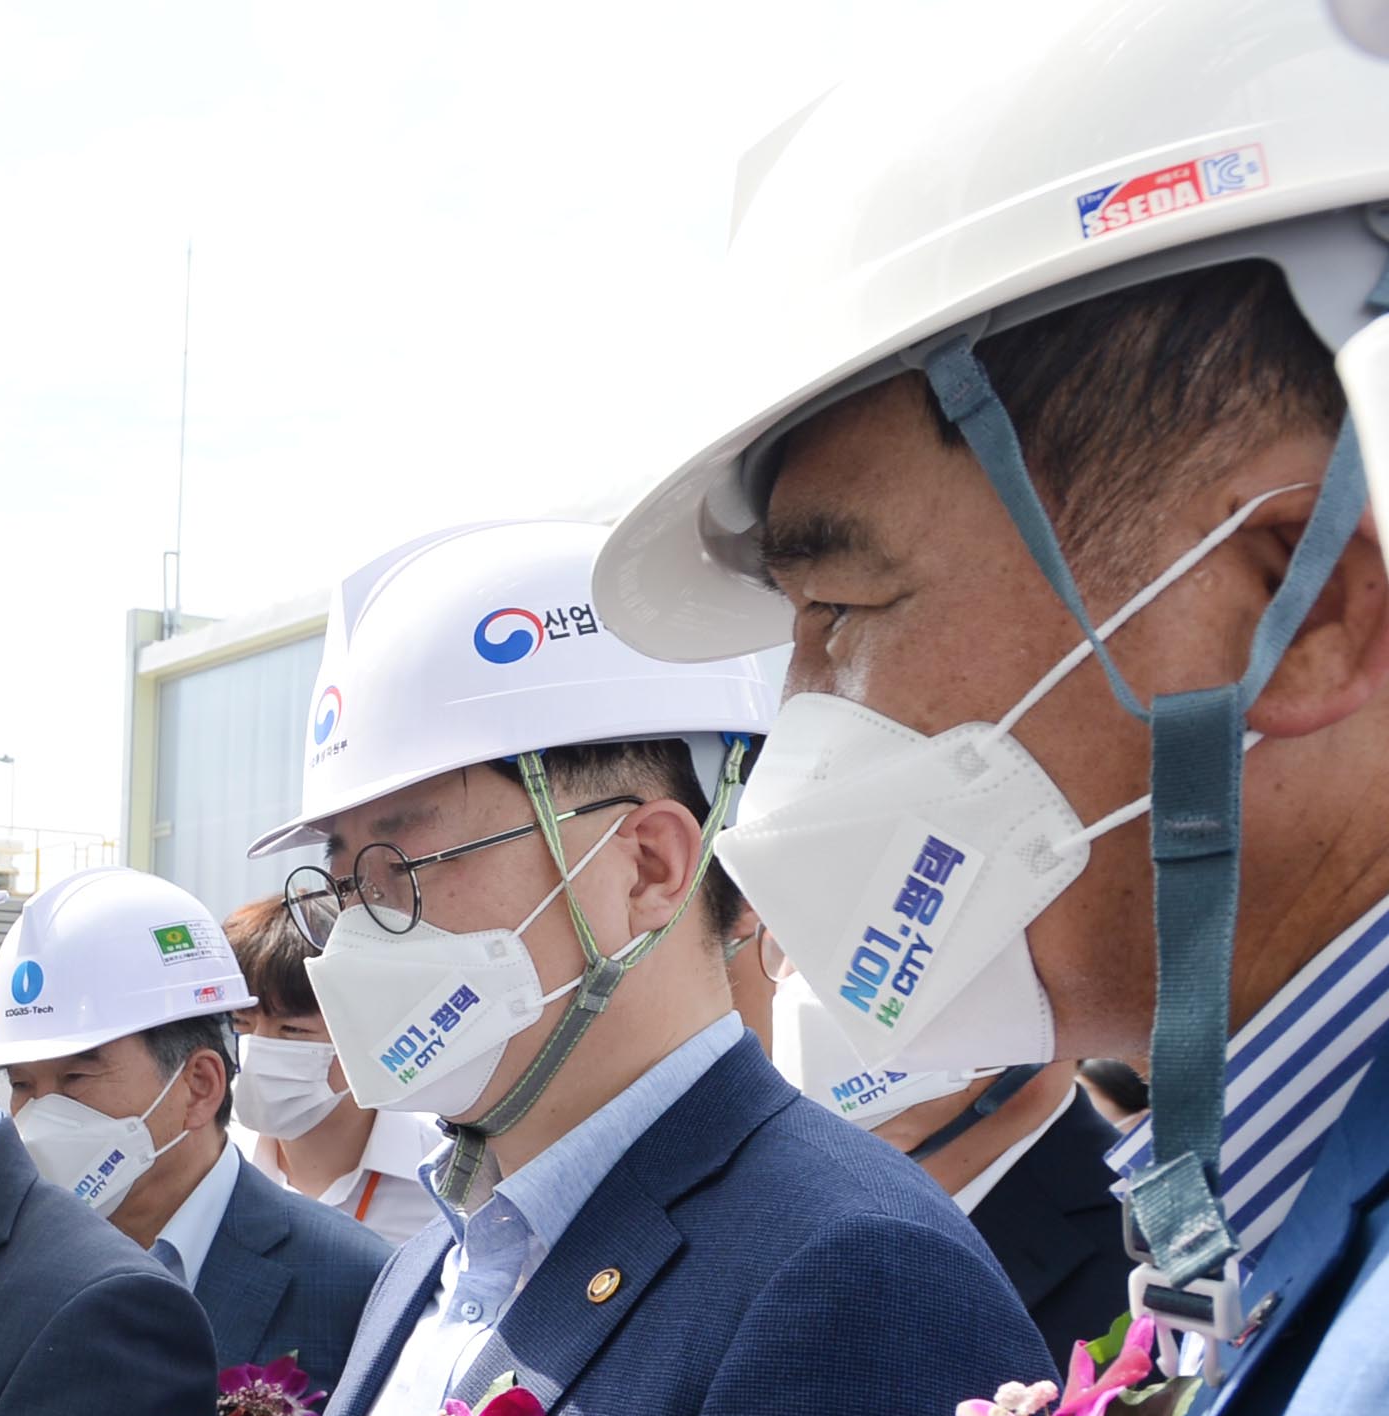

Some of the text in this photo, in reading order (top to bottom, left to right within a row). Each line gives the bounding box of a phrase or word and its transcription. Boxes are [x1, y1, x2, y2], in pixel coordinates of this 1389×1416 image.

[542, 602, 607, 641] 산업
[890, 931, 935, 997] CITY
[413, 1034, 446, 1069] CITY
[858, 1083, 887, 1105] CITY
